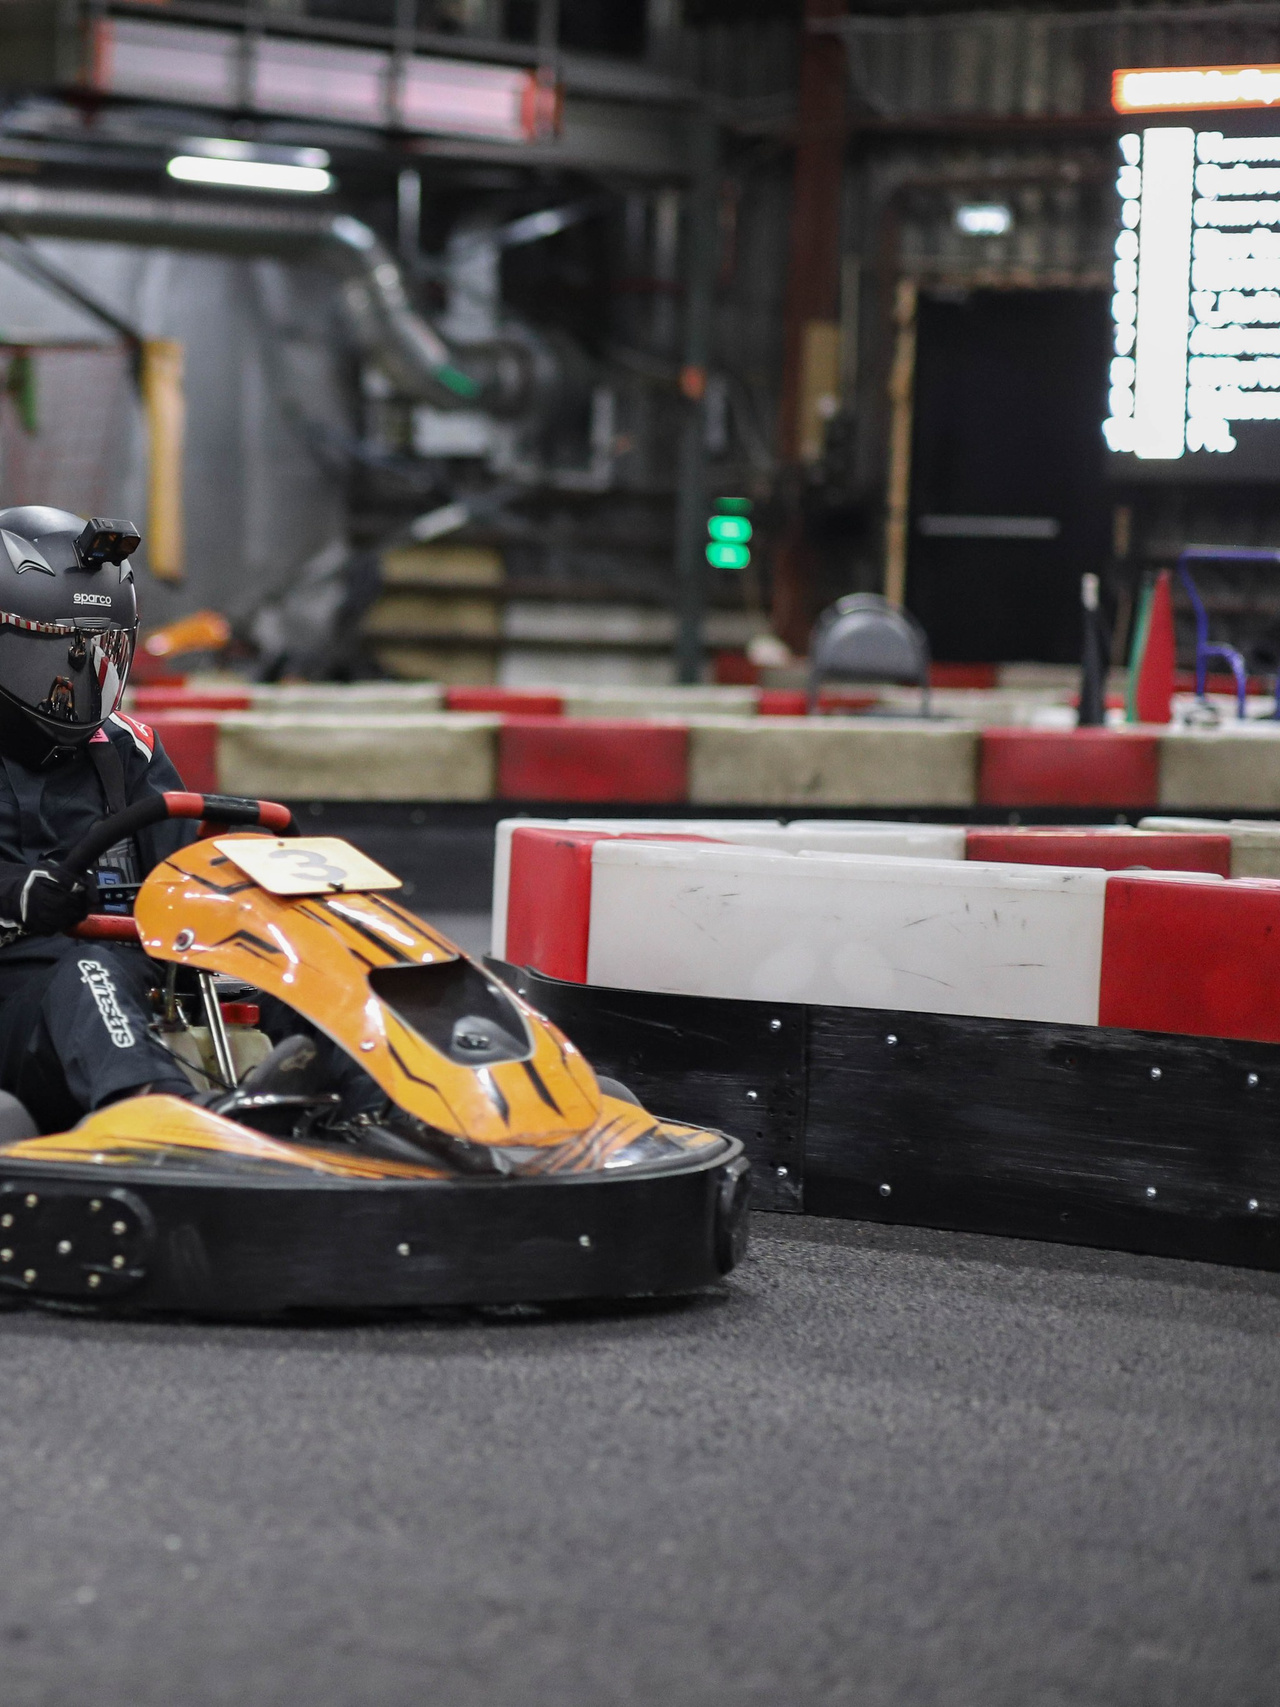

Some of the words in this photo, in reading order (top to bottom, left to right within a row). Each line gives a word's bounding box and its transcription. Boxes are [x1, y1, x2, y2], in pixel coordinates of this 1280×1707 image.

[73, 593, 112, 607] sparco
[269, 849, 347, 882] 3
[77, 959, 135, 1048] alpinestars
